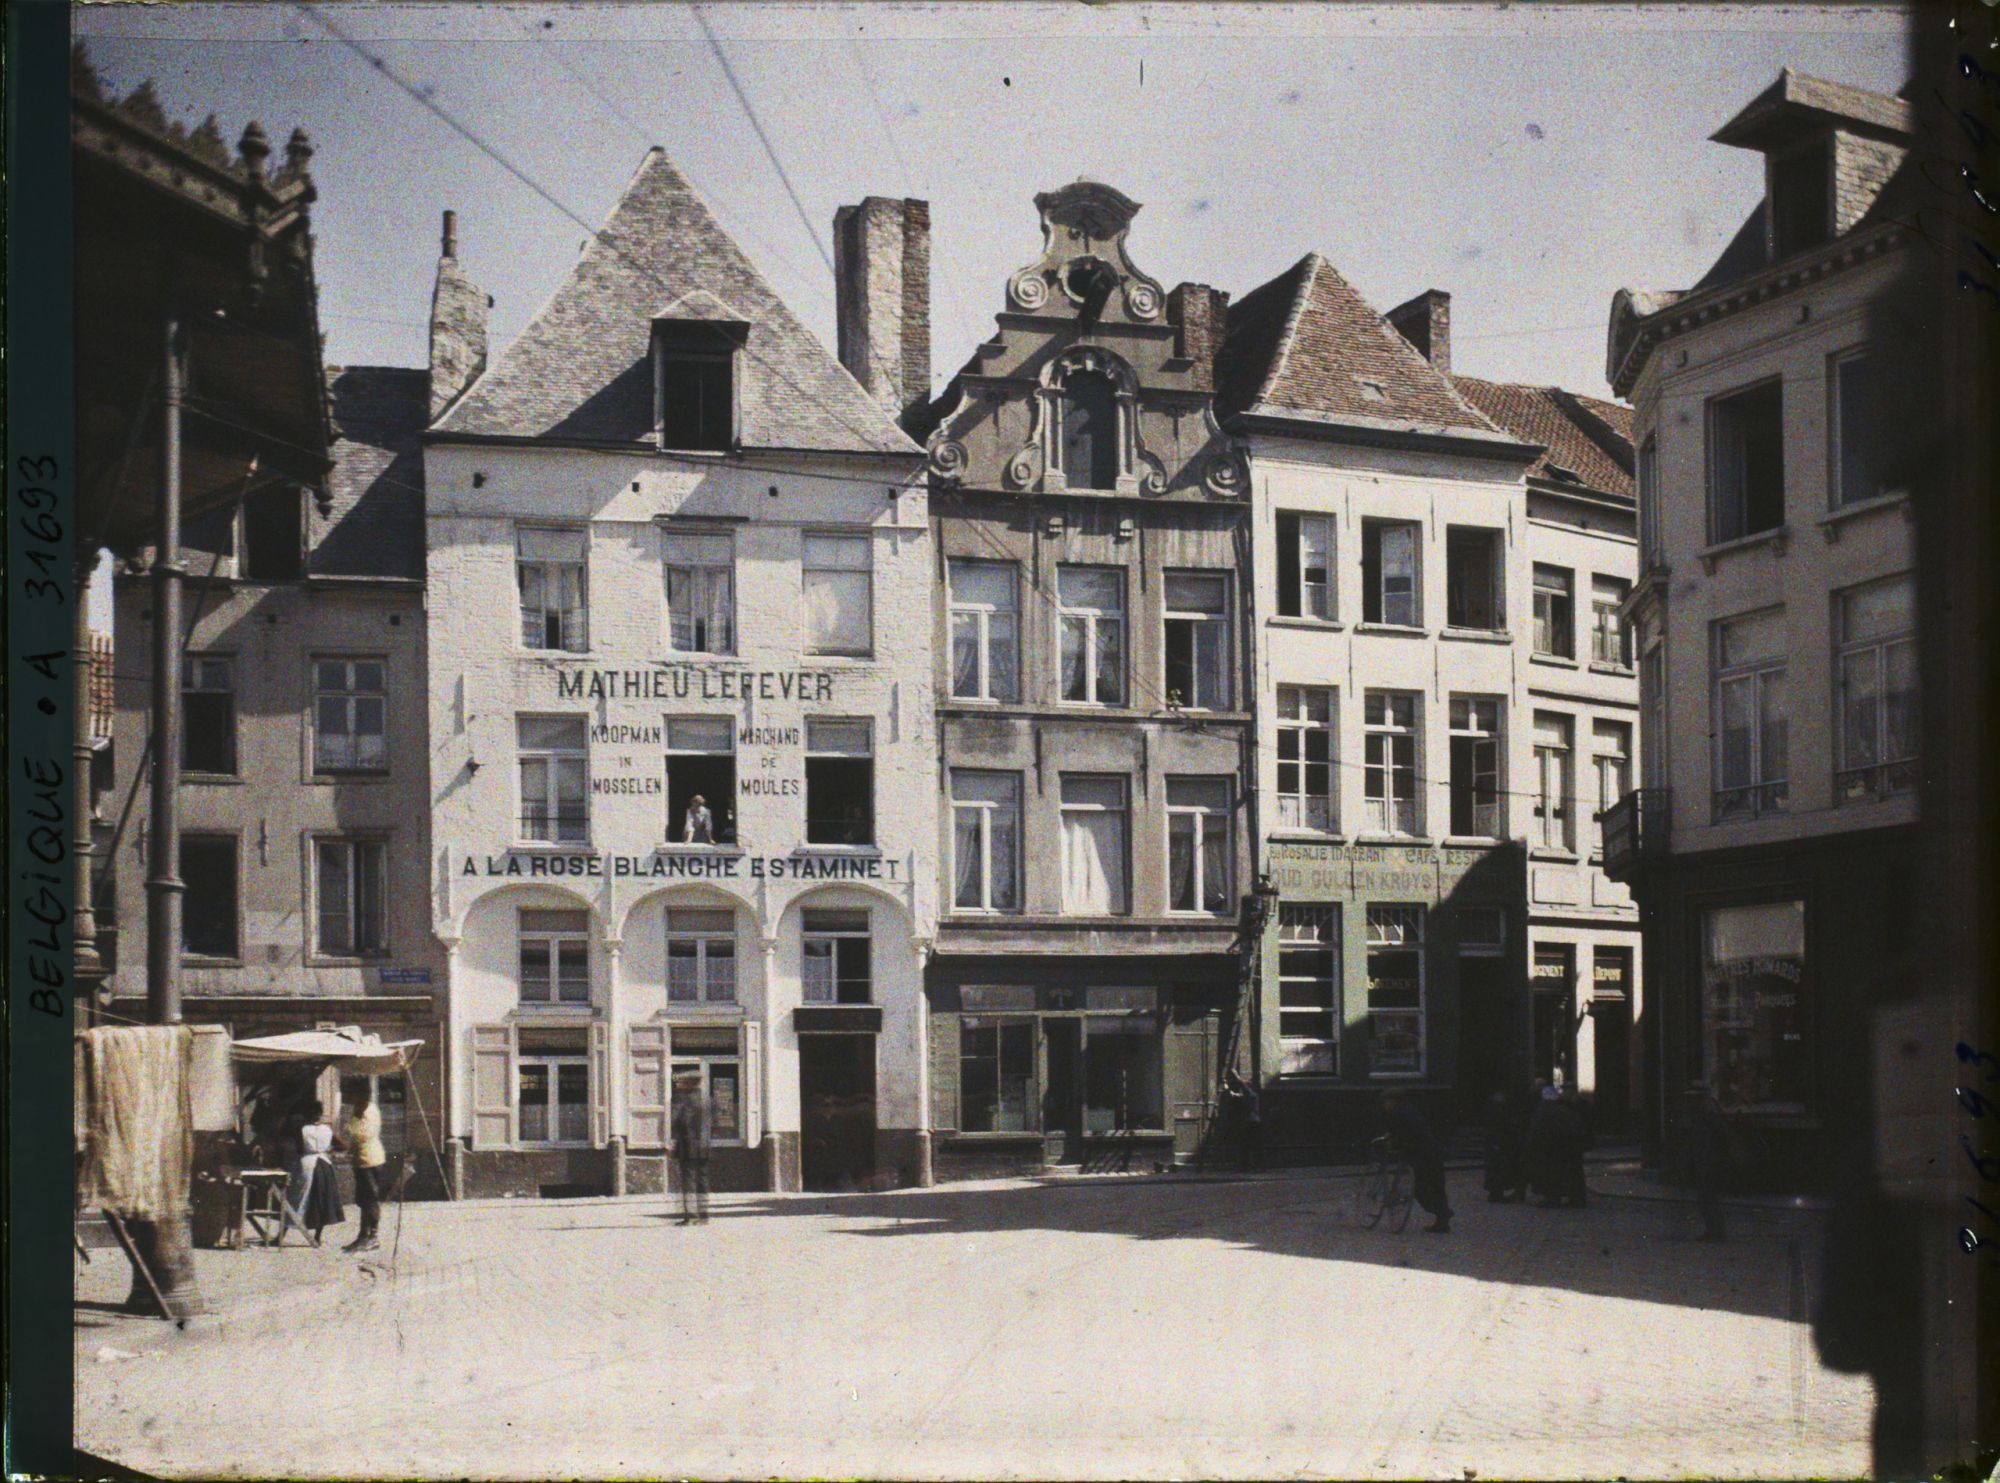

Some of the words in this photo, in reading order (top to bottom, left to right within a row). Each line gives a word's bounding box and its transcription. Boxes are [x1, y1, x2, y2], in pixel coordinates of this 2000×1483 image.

[17, 454, 63, 606] 31693
[559, 671, 689, 698] MATHIEU
[702, 672, 832, 700] LEFEVER
[591, 725, 661, 744] KOOPMAN
[739, 728, 800, 745] MARCHAND
[619, 757, 631, 768] IN
[761, 757, 776, 768] DE
[592, 778, 661, 794] MOSSELEN
[741, 779, 799, 795] MOULES
[463, 857, 475, 876] A
[488, 857, 521, 876] LA
[531, 857, 602, 876] ROSE
[614, 857, 738, 877] BLANCHE
[751, 858, 899, 879] ESTAMINET
